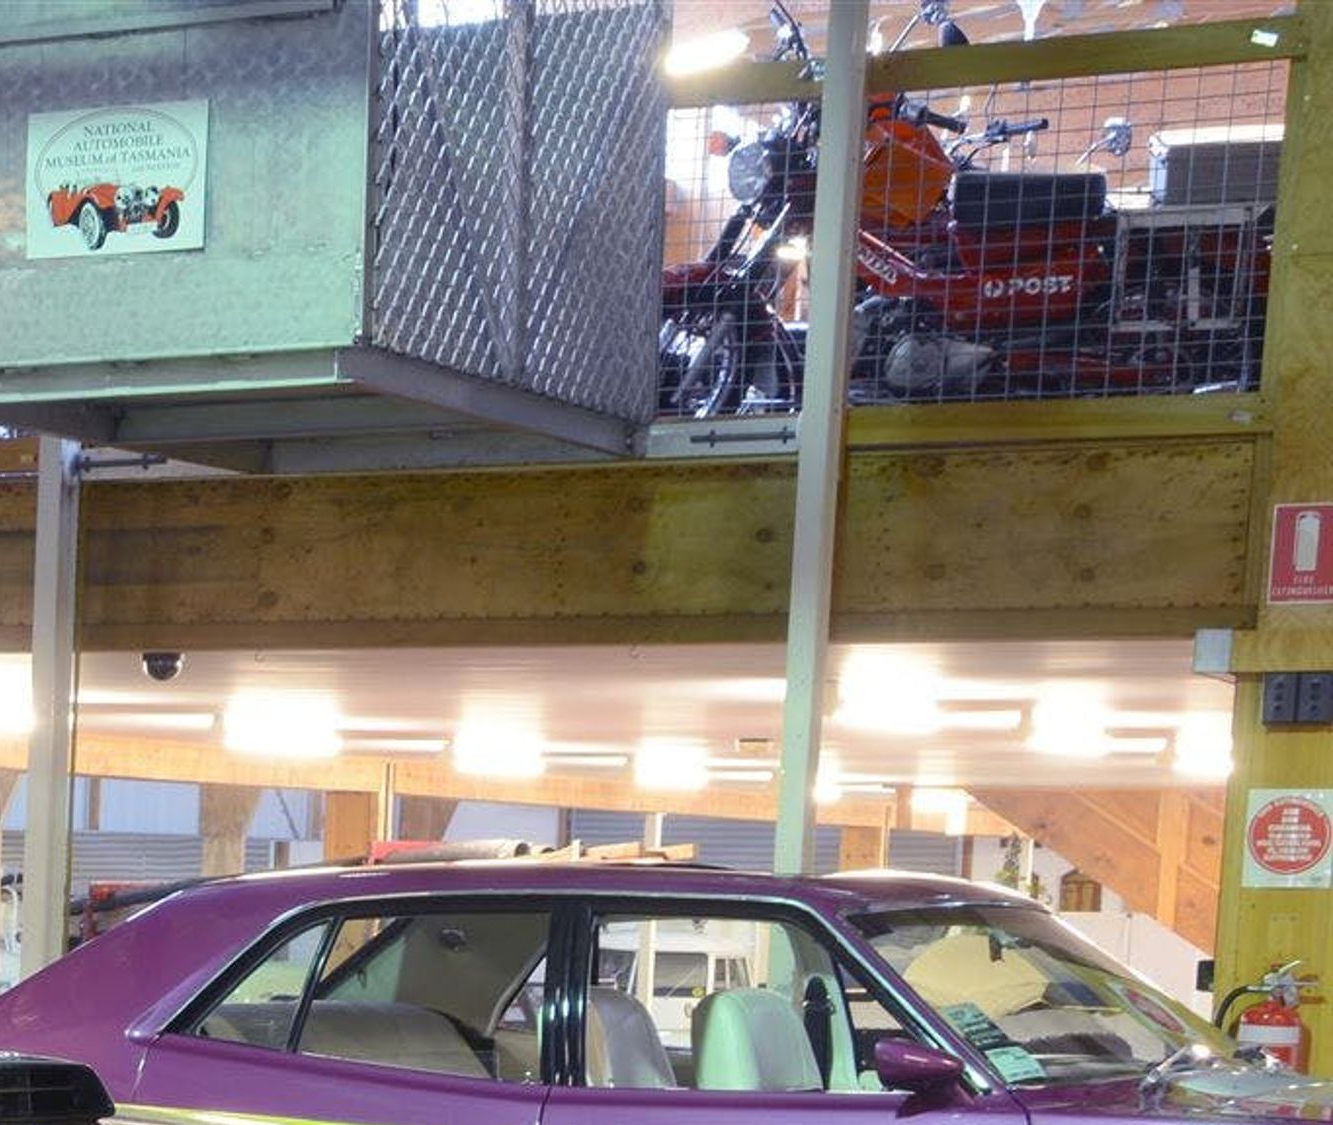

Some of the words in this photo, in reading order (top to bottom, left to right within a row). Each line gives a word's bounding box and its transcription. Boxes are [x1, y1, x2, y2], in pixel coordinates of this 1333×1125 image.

[83, 120, 156, 138] NATIONAL
[73, 134, 164, 152] AUTOMOBILE
[45, 153, 103, 168] MUSEUM
[121, 147, 191, 163] TASMANIA
[1007, 275, 1073, 297] POST
